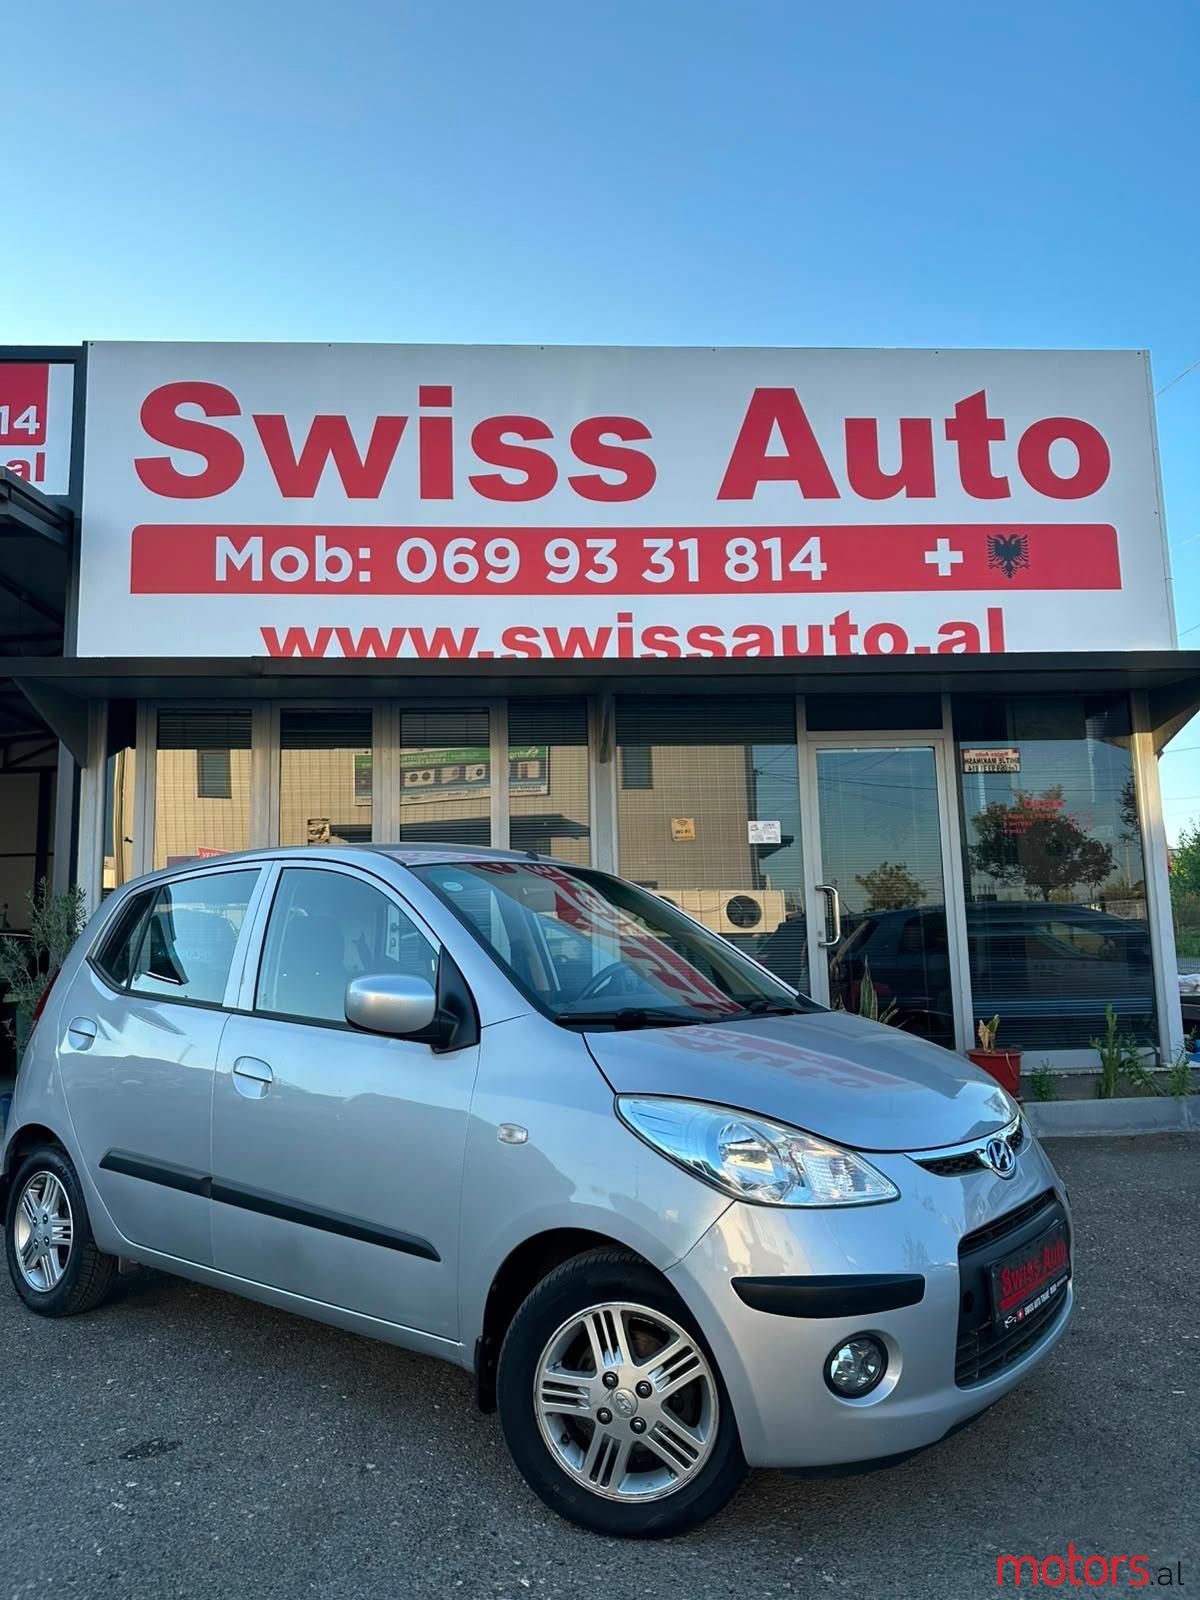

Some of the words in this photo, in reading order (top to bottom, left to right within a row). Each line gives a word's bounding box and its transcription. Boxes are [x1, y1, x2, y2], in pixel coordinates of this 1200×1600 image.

[135, 382, 657, 503] Swiss
[717, 388, 1110, 500] Auto
[214, 535, 372, 583] Mob:
[395, 537, 521, 584] 069
[544, 537, 619, 584] 93
[641, 537, 700, 583] 31
[723, 536, 829, 583] 814
[261, 608, 1005, 657] www.swissauto.al
